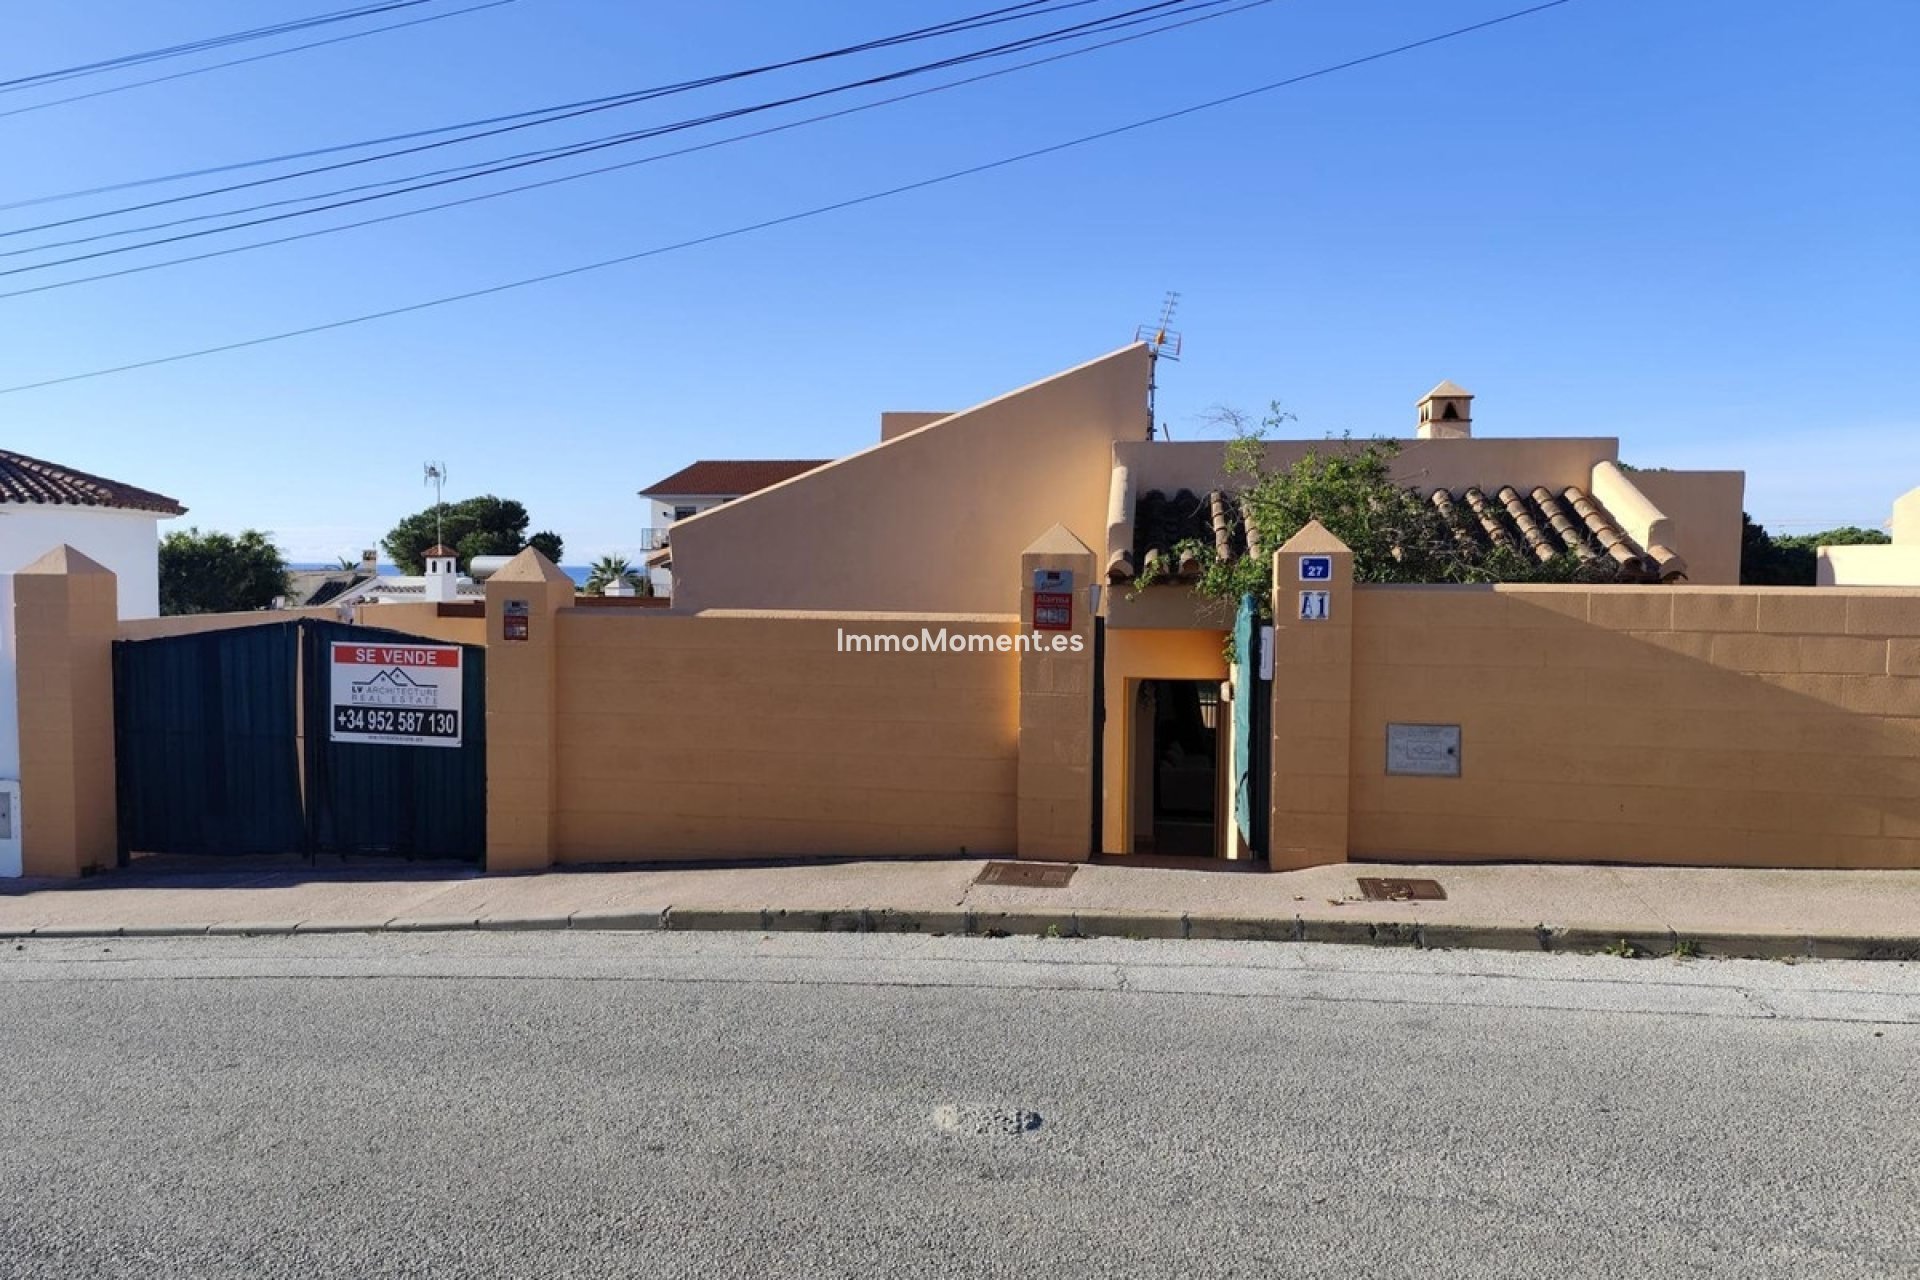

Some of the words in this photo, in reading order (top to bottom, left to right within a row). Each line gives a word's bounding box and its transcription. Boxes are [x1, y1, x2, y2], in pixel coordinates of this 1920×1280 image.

[1308, 566, 1324, 577] 27
[356, 648, 376, 662] SE
[382, 649, 438, 665] VENDE
[366, 686, 438, 697] ARCHITECTURE
[352, 694, 382, 703] REAL
[392, 695, 438, 705] ESTATE
[338, 708, 364, 729] +34
[367, 710, 394, 731] 952
[398, 711, 424, 732] 587
[428, 712, 454, 734] 130
